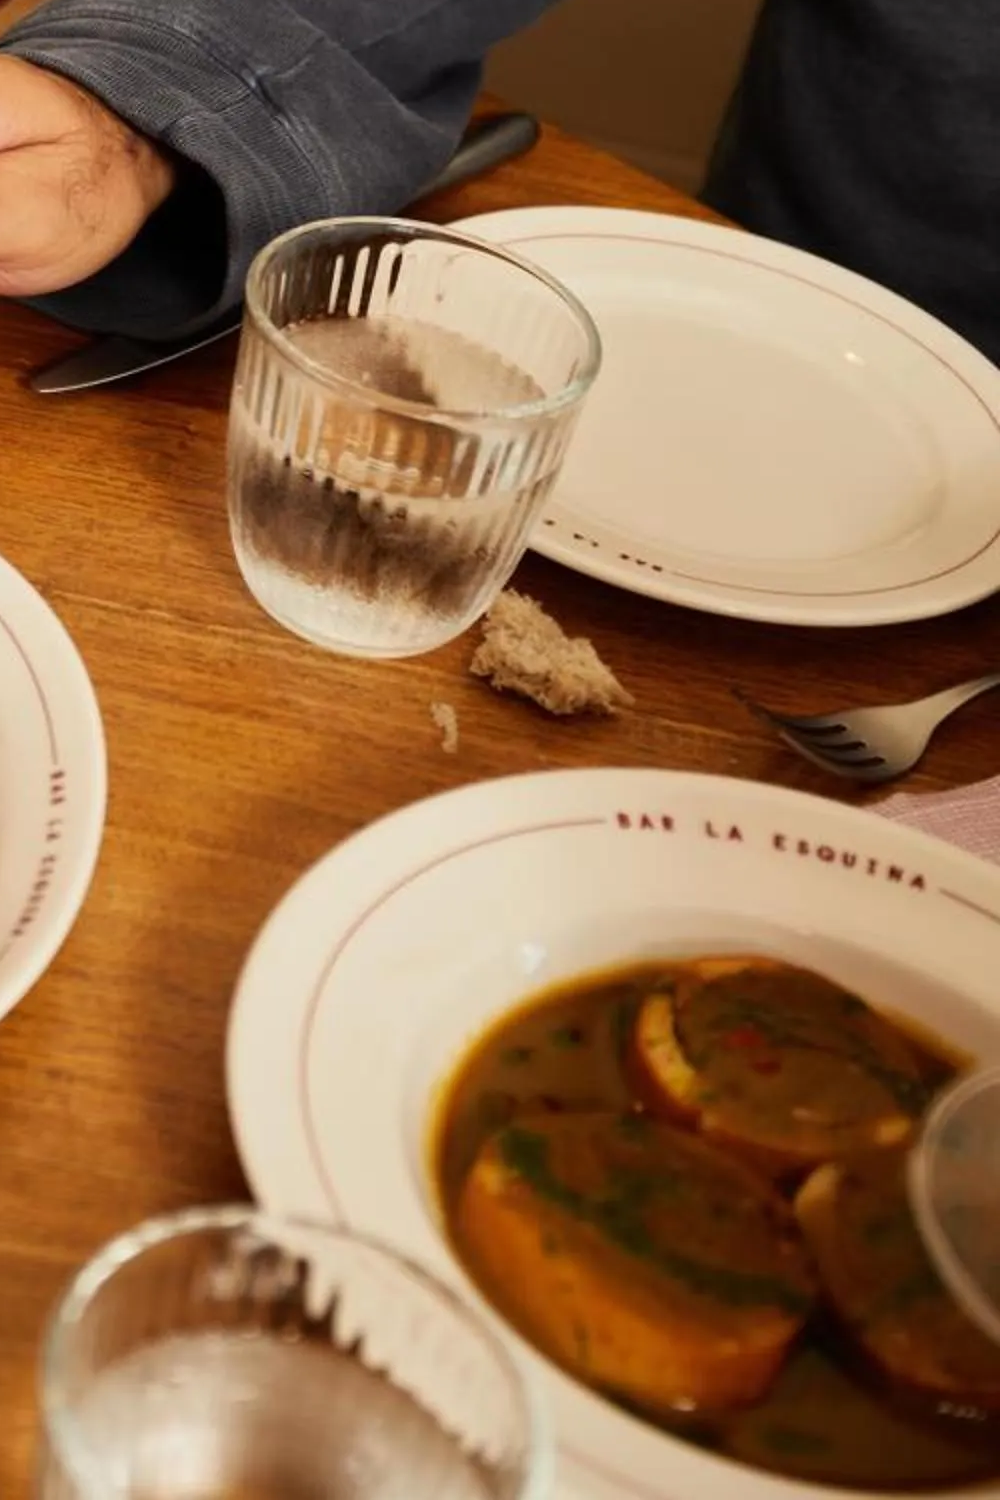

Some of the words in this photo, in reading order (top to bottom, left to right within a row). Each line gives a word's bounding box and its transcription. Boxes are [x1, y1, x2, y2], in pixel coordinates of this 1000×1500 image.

[616, 812, 676, 832] BAR
[705, 819, 744, 842] LA
[772, 832, 926, 891] ESQUINA
